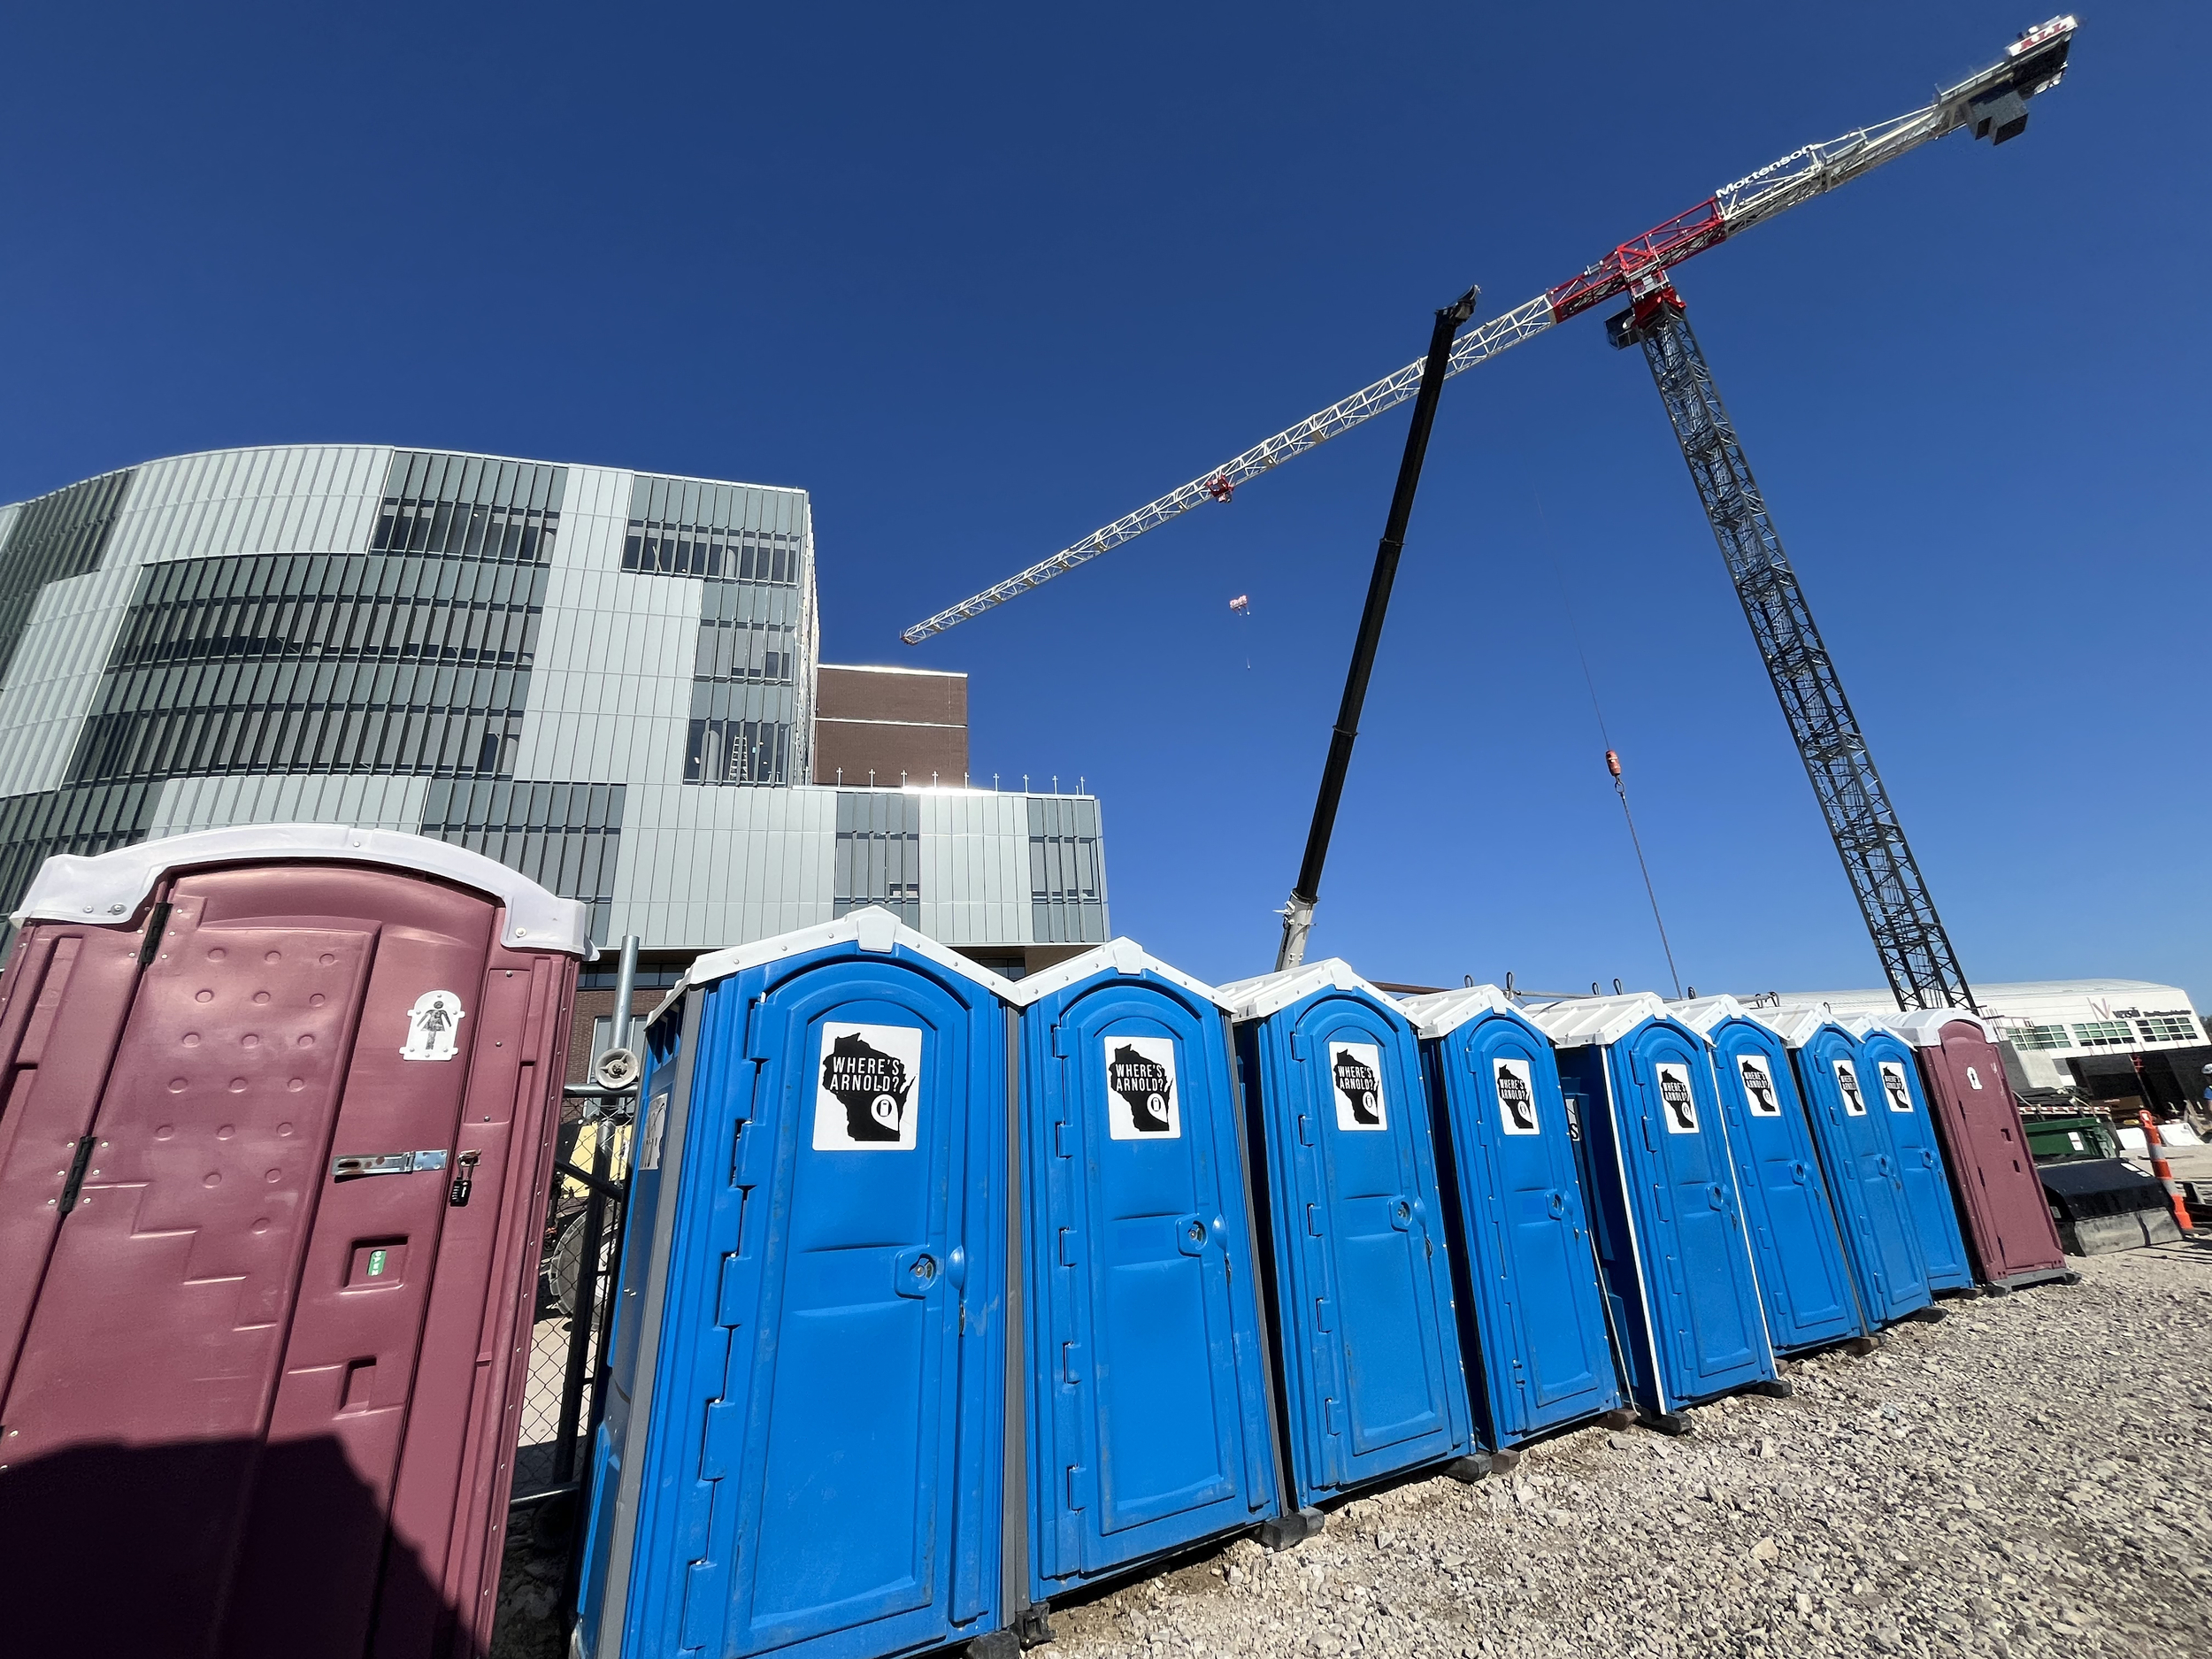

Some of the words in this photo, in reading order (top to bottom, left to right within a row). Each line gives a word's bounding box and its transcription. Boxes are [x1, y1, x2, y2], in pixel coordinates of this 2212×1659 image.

[1716, 144, 1816, 198] Mortenson
[833, 1056, 901, 1075] WHERE'S
[1115, 1064, 1163, 1078] WHERE'S
[1337, 1065, 1372, 1079] WHERE'S
[829, 1074, 900, 1092] ARNOLD?
[1116, 1078, 1164, 1092] ARNOLD?
[1339, 1078, 1373, 1090] ARNOLD?
